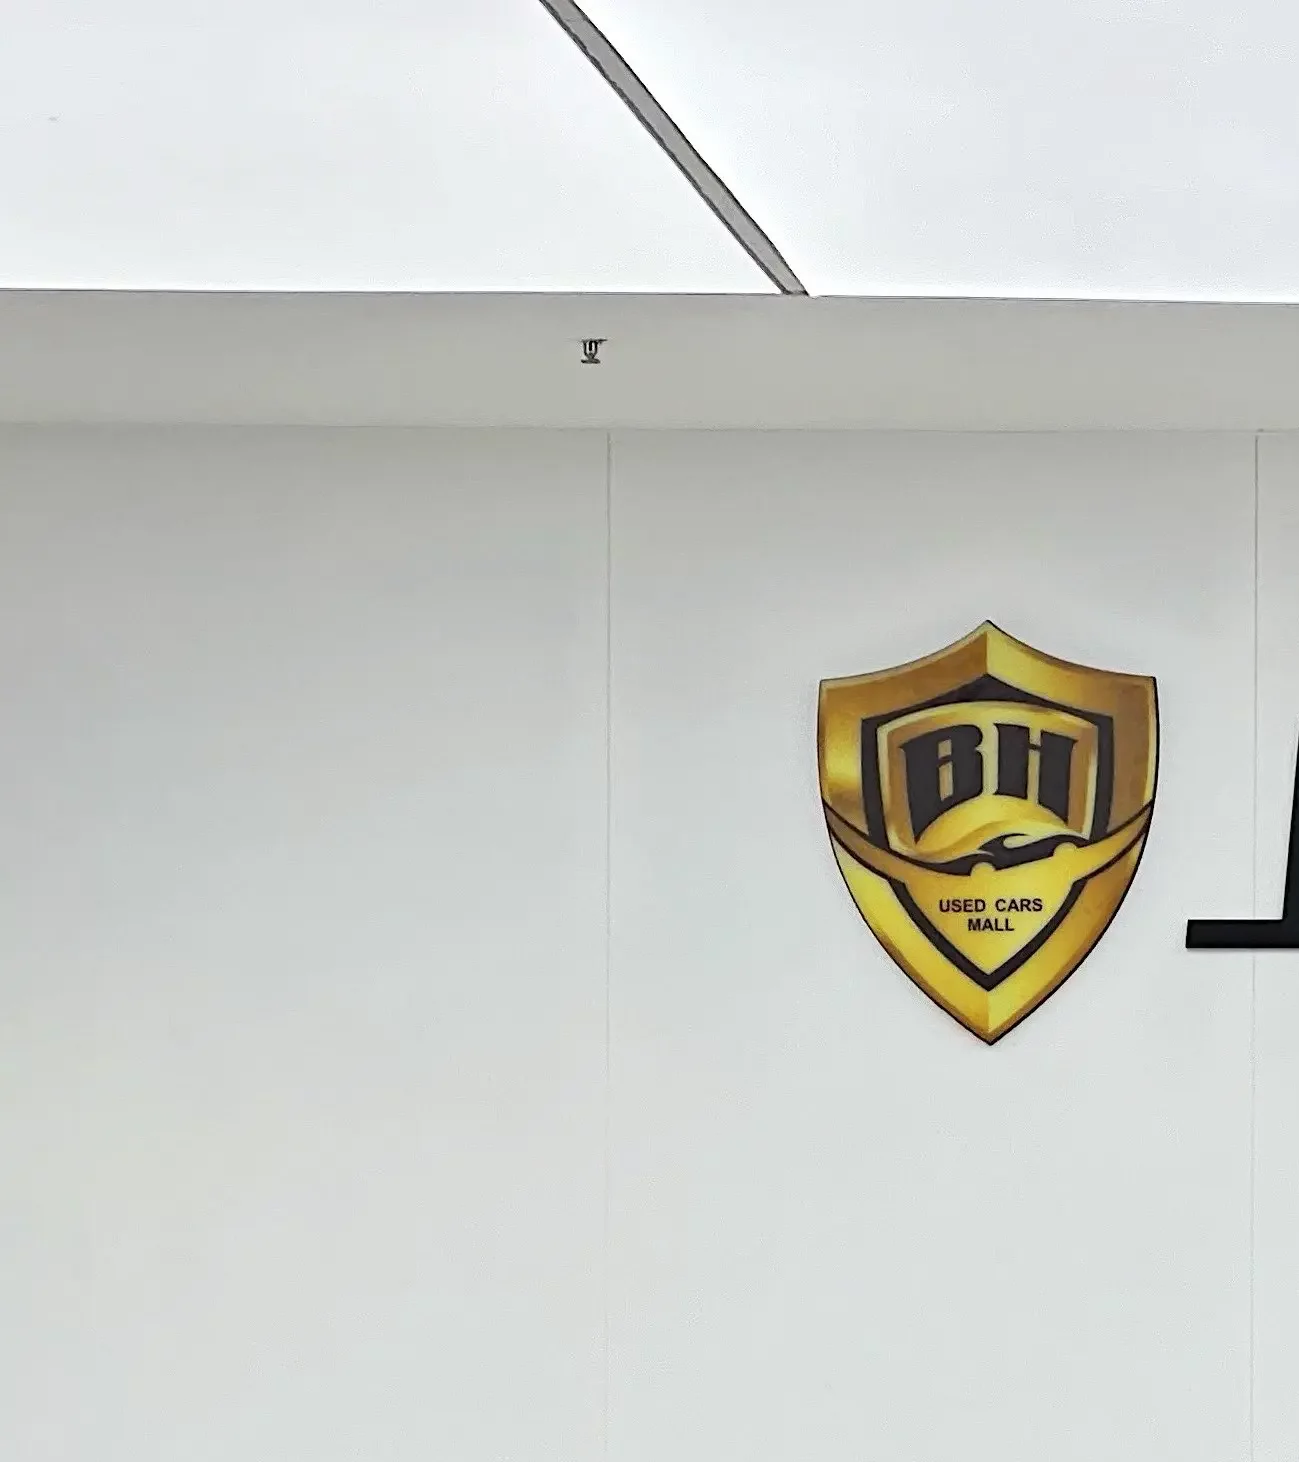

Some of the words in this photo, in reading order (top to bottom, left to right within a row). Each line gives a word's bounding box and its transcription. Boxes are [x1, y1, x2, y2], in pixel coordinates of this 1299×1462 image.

[901, 723, 1077, 840] BH
[939, 898, 986, 912] USED
[995, 898, 1043, 912] CARS
[967, 918, 1014, 931] MALL
